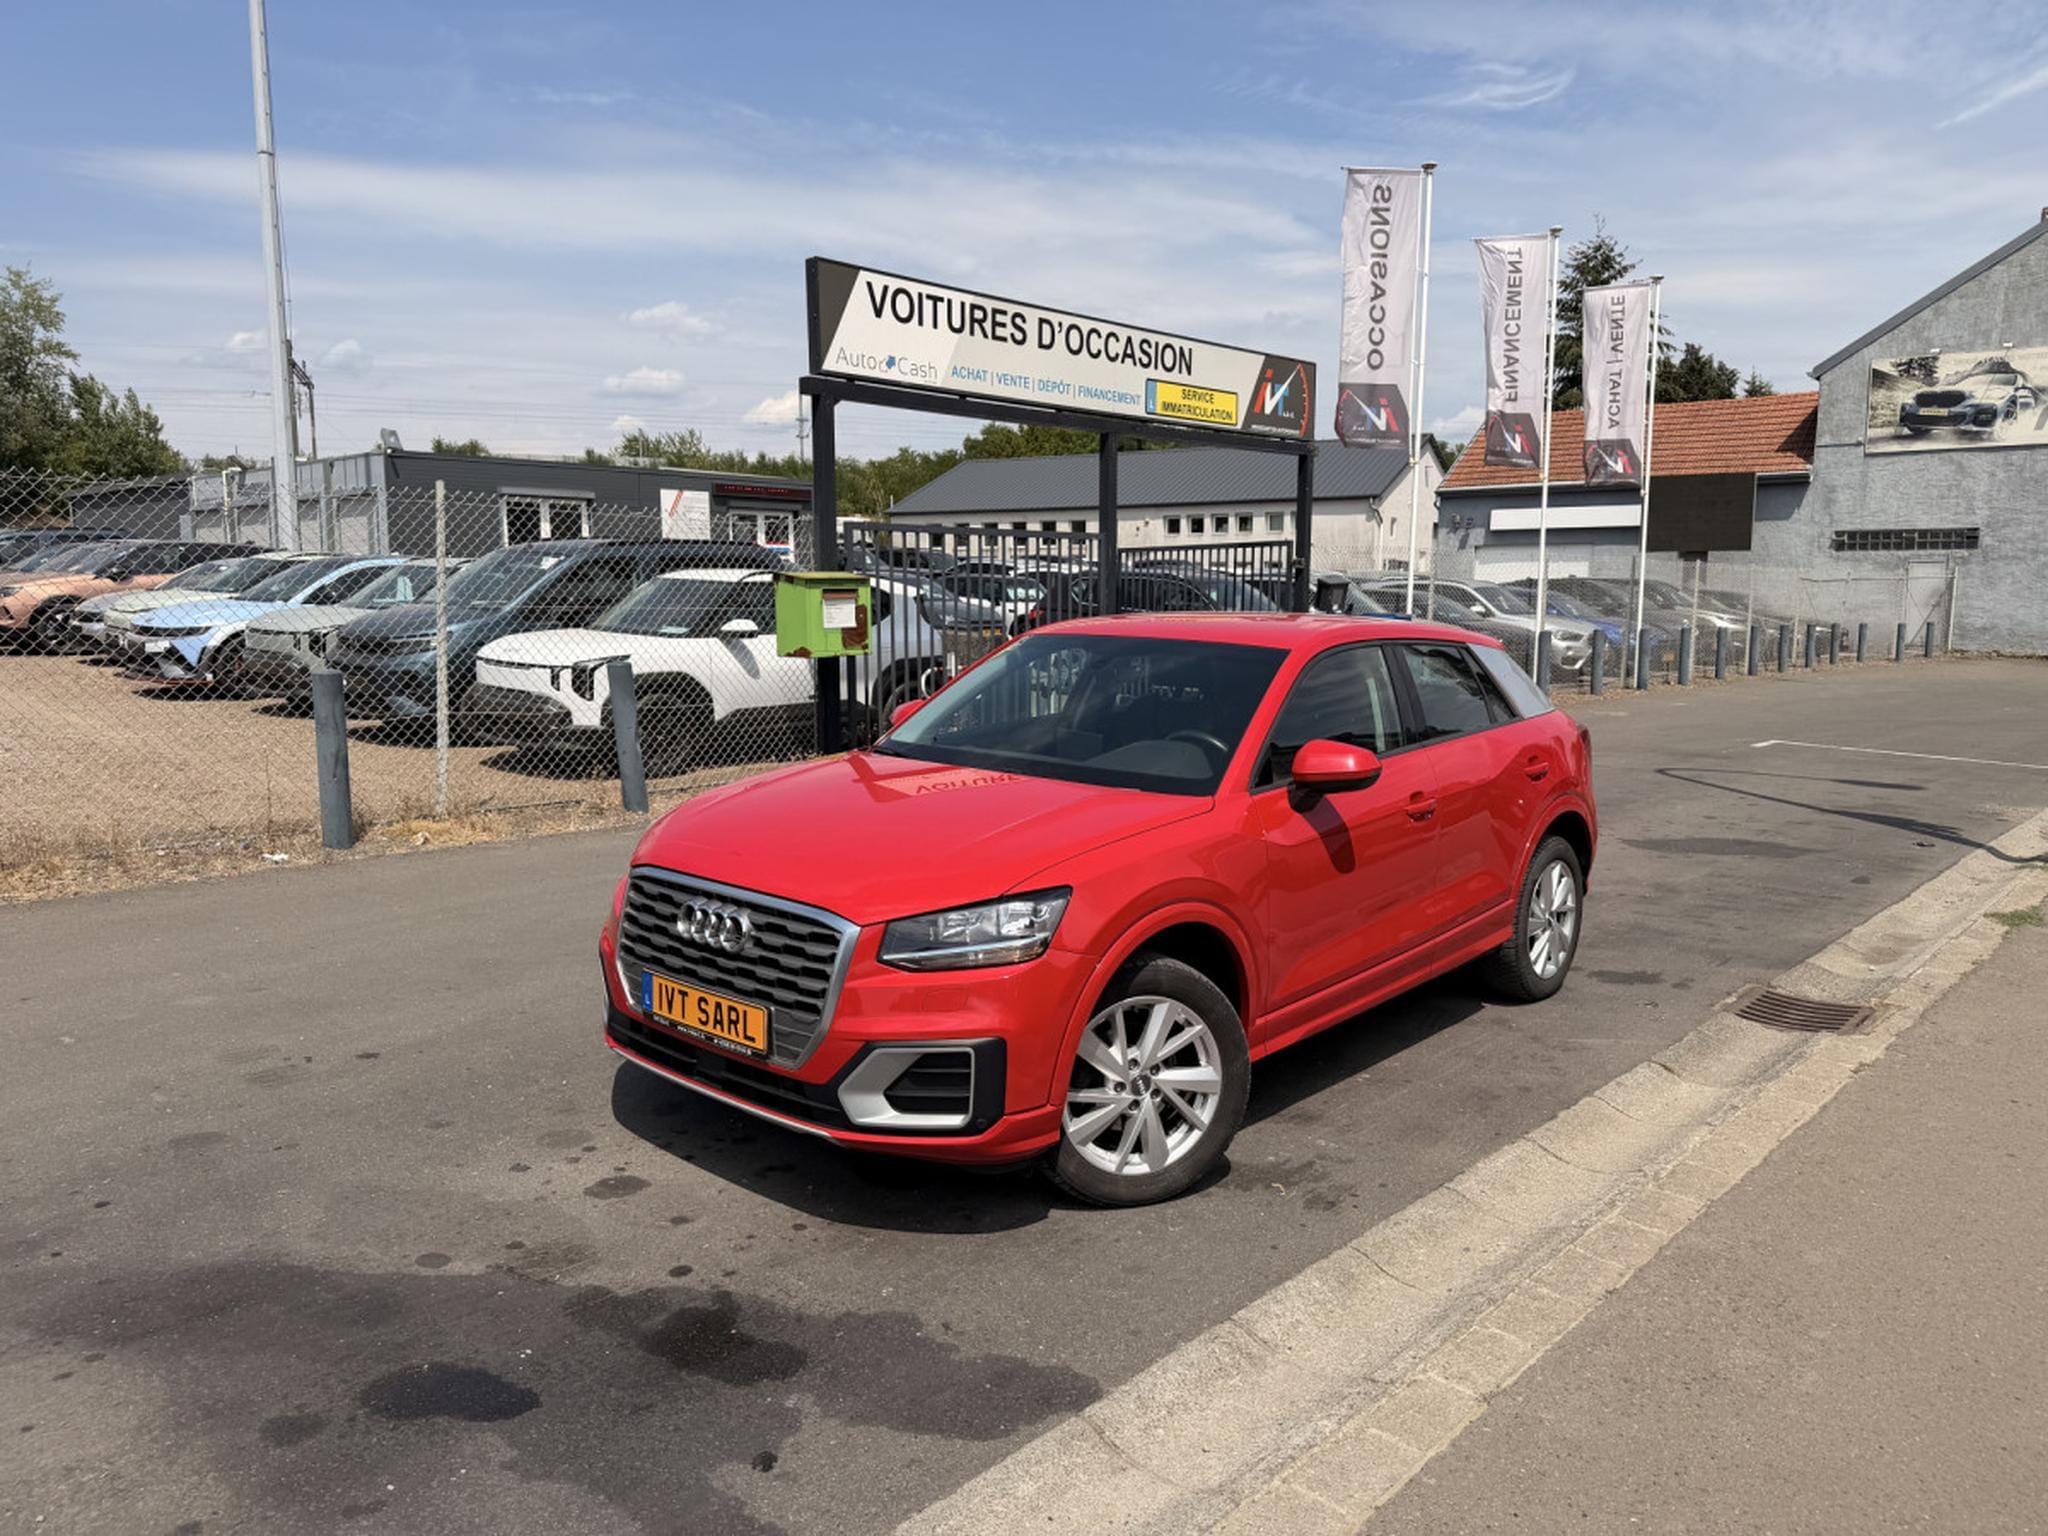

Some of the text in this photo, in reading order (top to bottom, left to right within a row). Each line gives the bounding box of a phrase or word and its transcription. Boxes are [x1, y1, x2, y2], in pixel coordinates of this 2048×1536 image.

[865, 280, 1194, 377] VOITURES D'OCCASION
[951, 364, 1142, 406] ACHAT VENTE DÉPÔT FINANCEMENT
[1181, 388, 1215, 404] SERVICE
[1161, 400, 1234, 421] IMMATRICULATION
[657, 981, 757, 1044] IVT SARL
